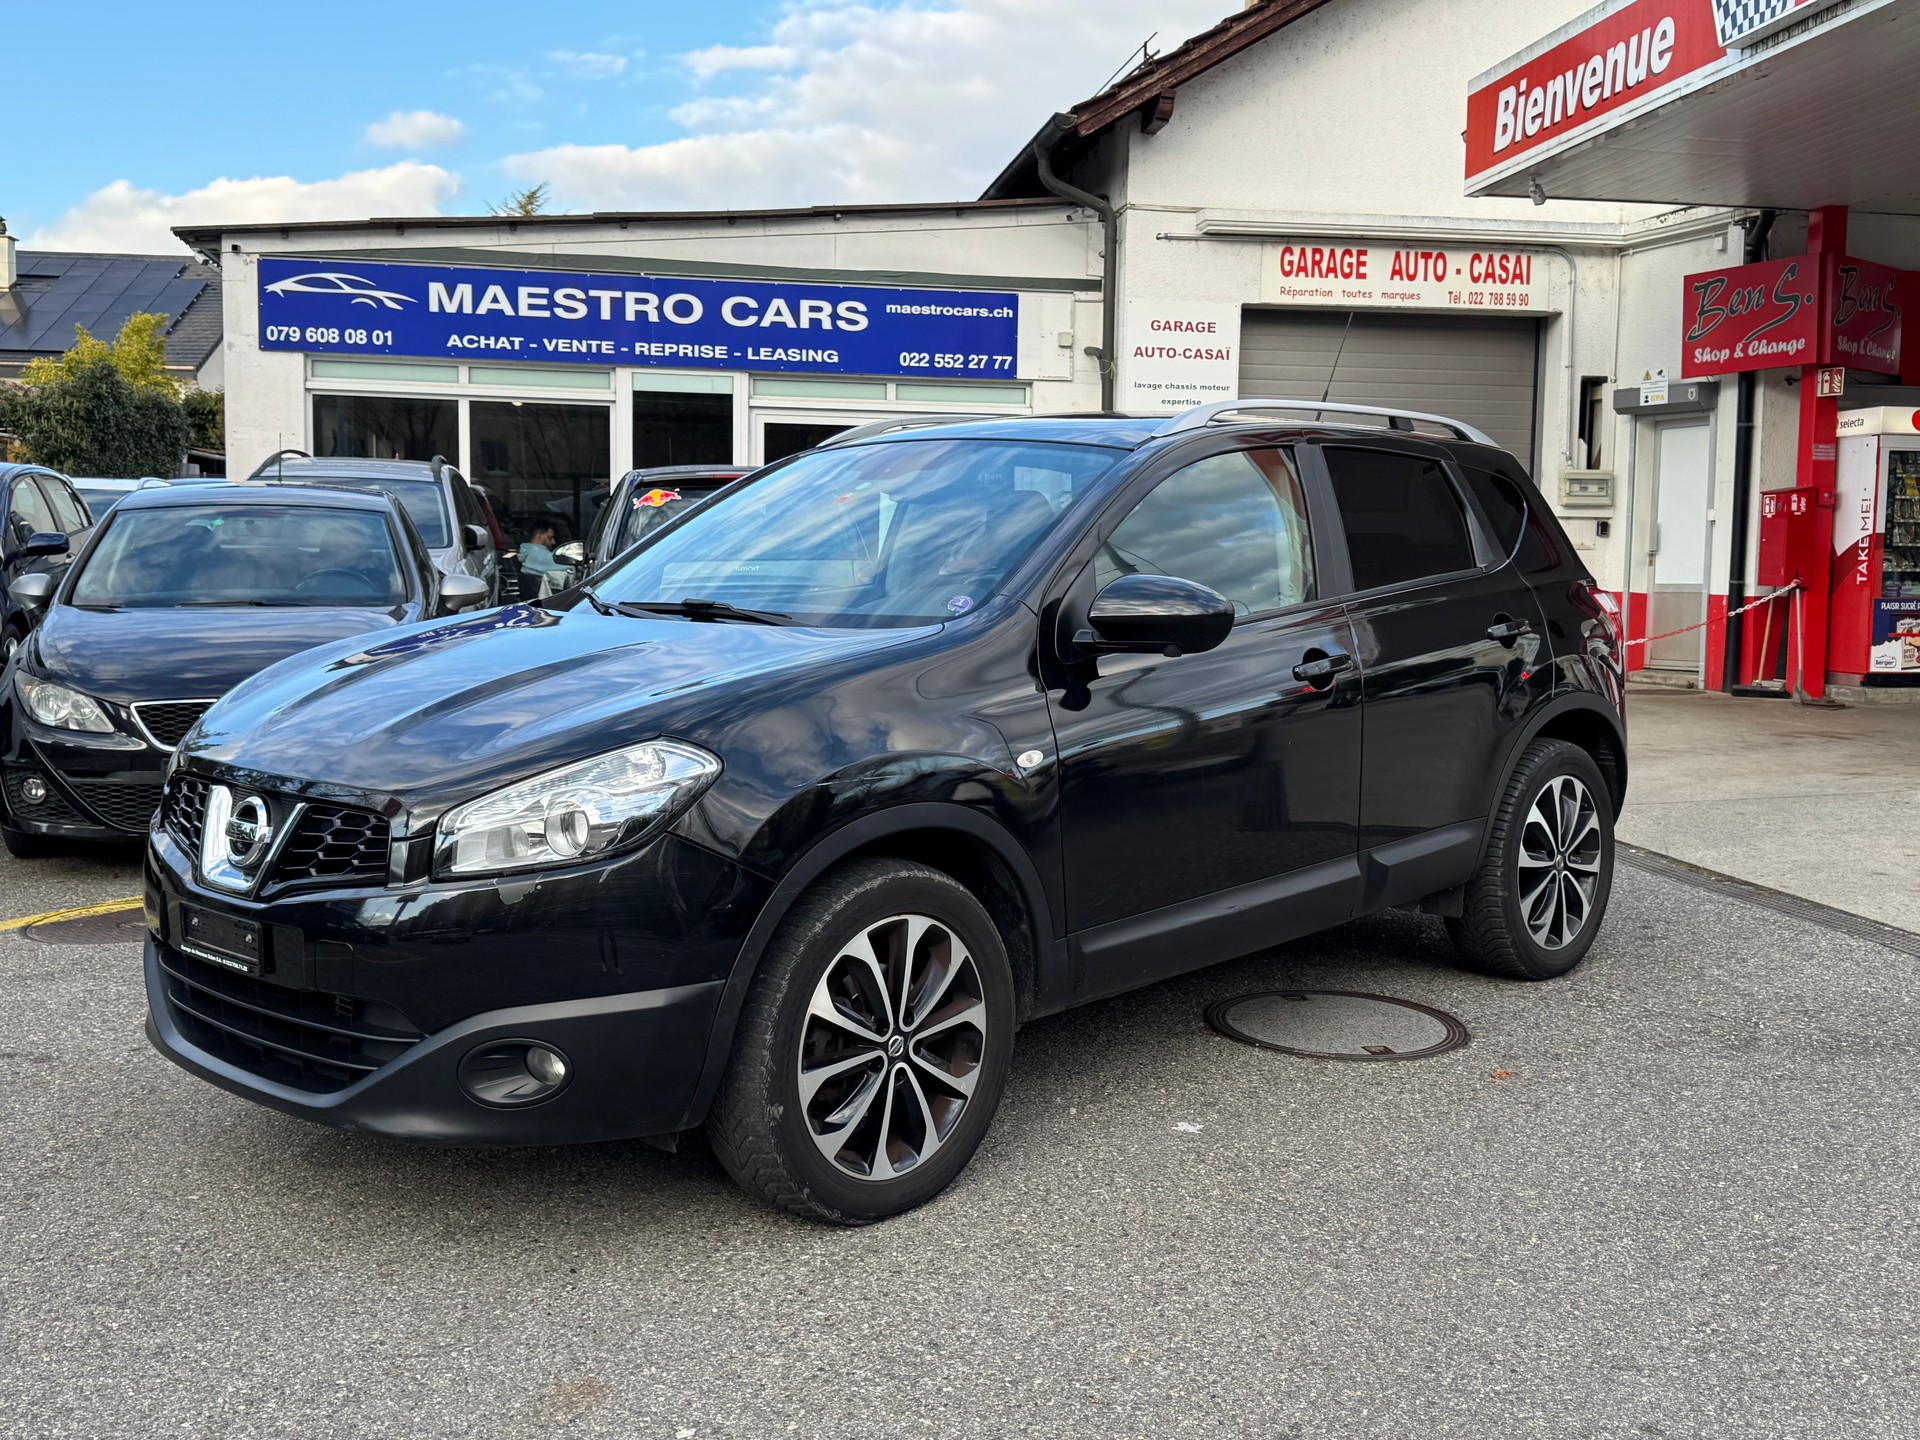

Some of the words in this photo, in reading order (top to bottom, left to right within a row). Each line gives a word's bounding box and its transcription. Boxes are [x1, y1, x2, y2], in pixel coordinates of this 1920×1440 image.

[1493, 16, 1675, 153] Bienvenue
[1279, 246, 1368, 280] GARAGE
[1389, 250, 1447, 283] AUTO
[1469, 252, 1532, 286] CASAI
[1280, 286, 1333, 298] Réparation
[1341, 289, 1373, 299] toutes
[1381, 291, 1421, 301] marques
[1468, 292, 1484, 305] 022
[1489, 293, 1504, 306] 788
[1506, 293, 1517, 306] 59
[1518, 294, 1529, 307] 90
[1834, 264, 1880, 326] Ben
[428, 281, 704, 326] MAESTRO
[721, 295, 869, 332] CARS
[885, 303, 1014, 319] maestrocars.ch
[1686, 276, 1766, 342] Ben
[266, 325, 301, 343] 079
[305, 326, 340, 344] 608
[344, 328, 368, 345] 08
[372, 329, 393, 346] 01
[1150, 319, 1217, 334] GARAGE
[446, 333, 525, 350] ACHAT
[542, 337, 616, 354] VENTE
[634, 342, 729, 359] REPRISE
[747, 346, 839, 363] LEASING
[1133, 346, 1231, 361] AUTO-CASAÏ
[1694, 347, 1730, 364] Shop
[1733, 343, 1745, 358] &
[1748, 337, 1806, 357] Change
[1837, 335, 1858, 354] Shop
[1859, 339, 1866, 355] &
[1867, 341, 1897, 363] Change
[899, 351, 930, 368] 022
[933, 352, 965, 369] 552
[967, 353, 989, 370] 27
[992, 355, 1013, 371] 77
[1134, 381, 1162, 391] lavage
[1165, 382, 1197, 390] chassis
[1161, 398, 1202, 406] expertise
[1839, 417, 1865, 429] selecta
[1860, 498, 1871, 531] ME!
[1856, 536, 1870, 585] TAKE
[1881, 602, 1899, 610] PLAISIR
[1900, 600, 1917, 611] SUCRÉ
